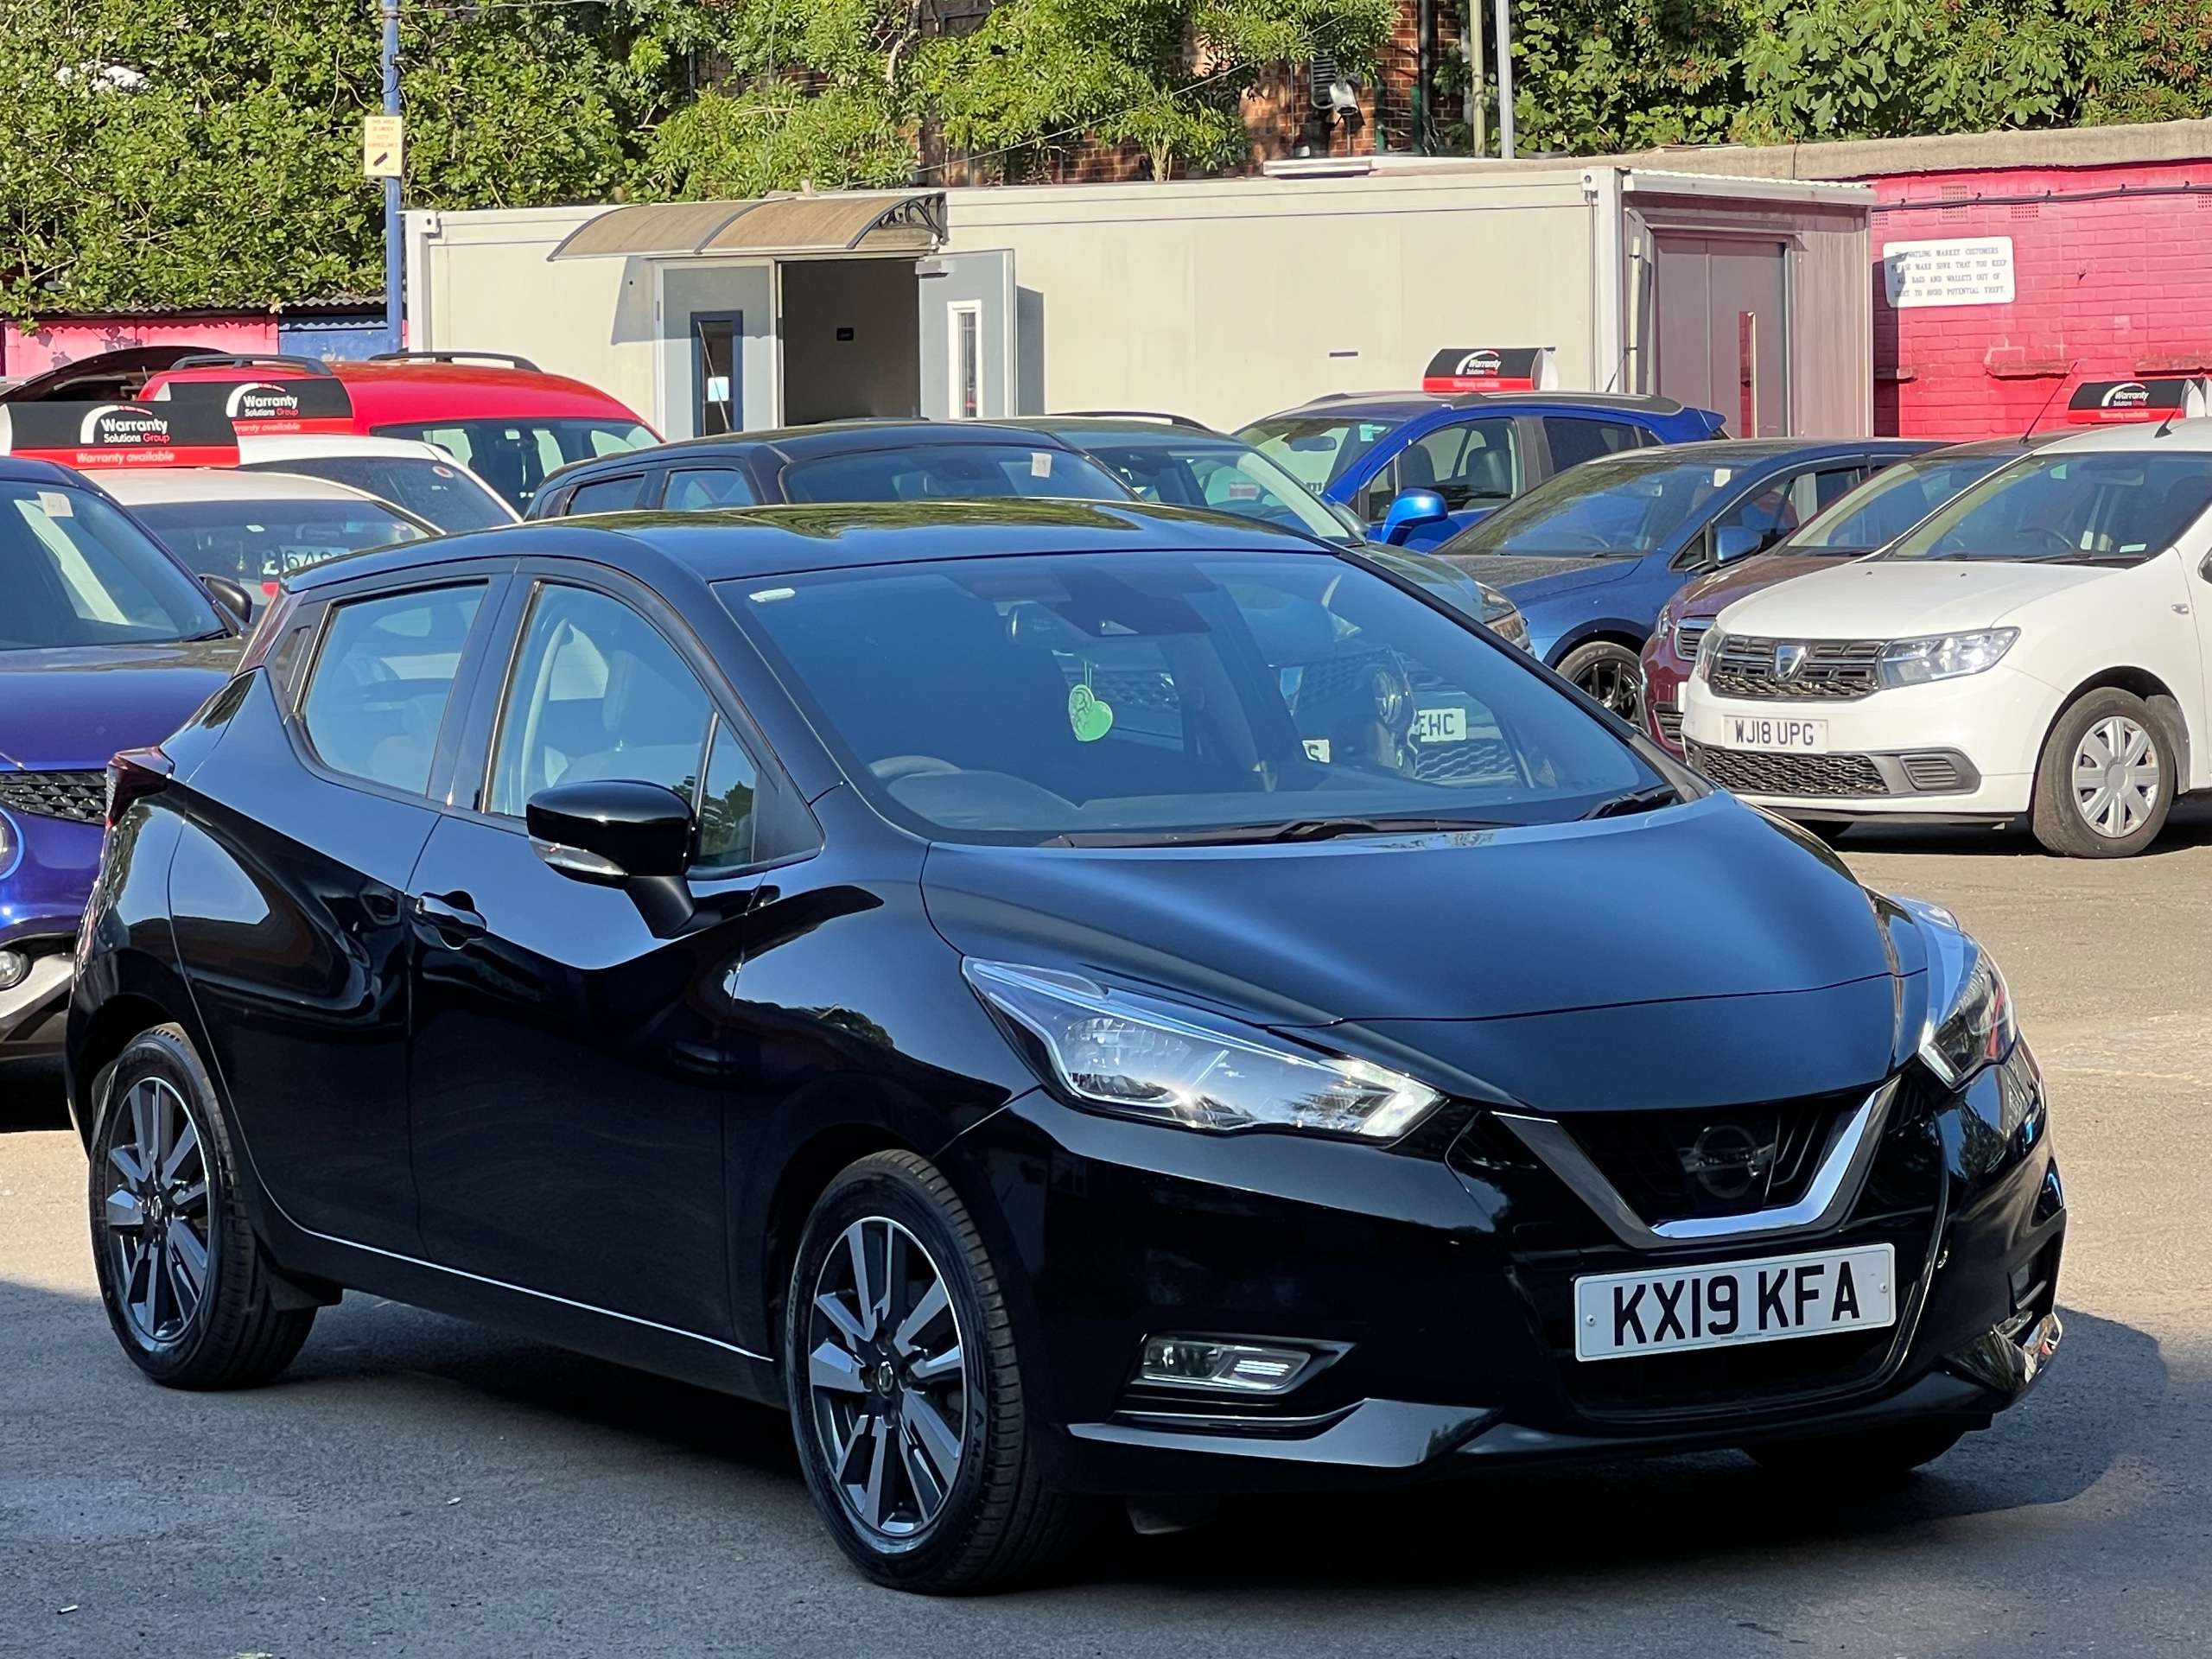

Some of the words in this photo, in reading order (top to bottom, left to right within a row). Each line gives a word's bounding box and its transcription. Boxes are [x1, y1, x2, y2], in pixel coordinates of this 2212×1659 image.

[1947, 287, 1979, 296] POTENTIAL
[1469, 359, 1502, 370] Warranty
[2114, 391, 2150, 401] Warranty
[243, 395, 298, 410] Warranty
[245, 408, 276, 416] Solutions
[276, 408, 299, 416] Group
[100, 418, 168, 435] Warranty
[234, 424, 259, 433] rranty
[261, 422, 301, 431] available
[104, 433, 142, 443] Solutions
[143, 433, 170, 443] Group
[76, 452, 124, 465] Warranty
[126, 450, 175, 461] available
[1735, 720, 1771, 744] WJ18
[1777, 722, 1814, 745] UPG
[1613, 1274, 1738, 1346] KX19
[1758, 1261, 1860, 1330] KFA
